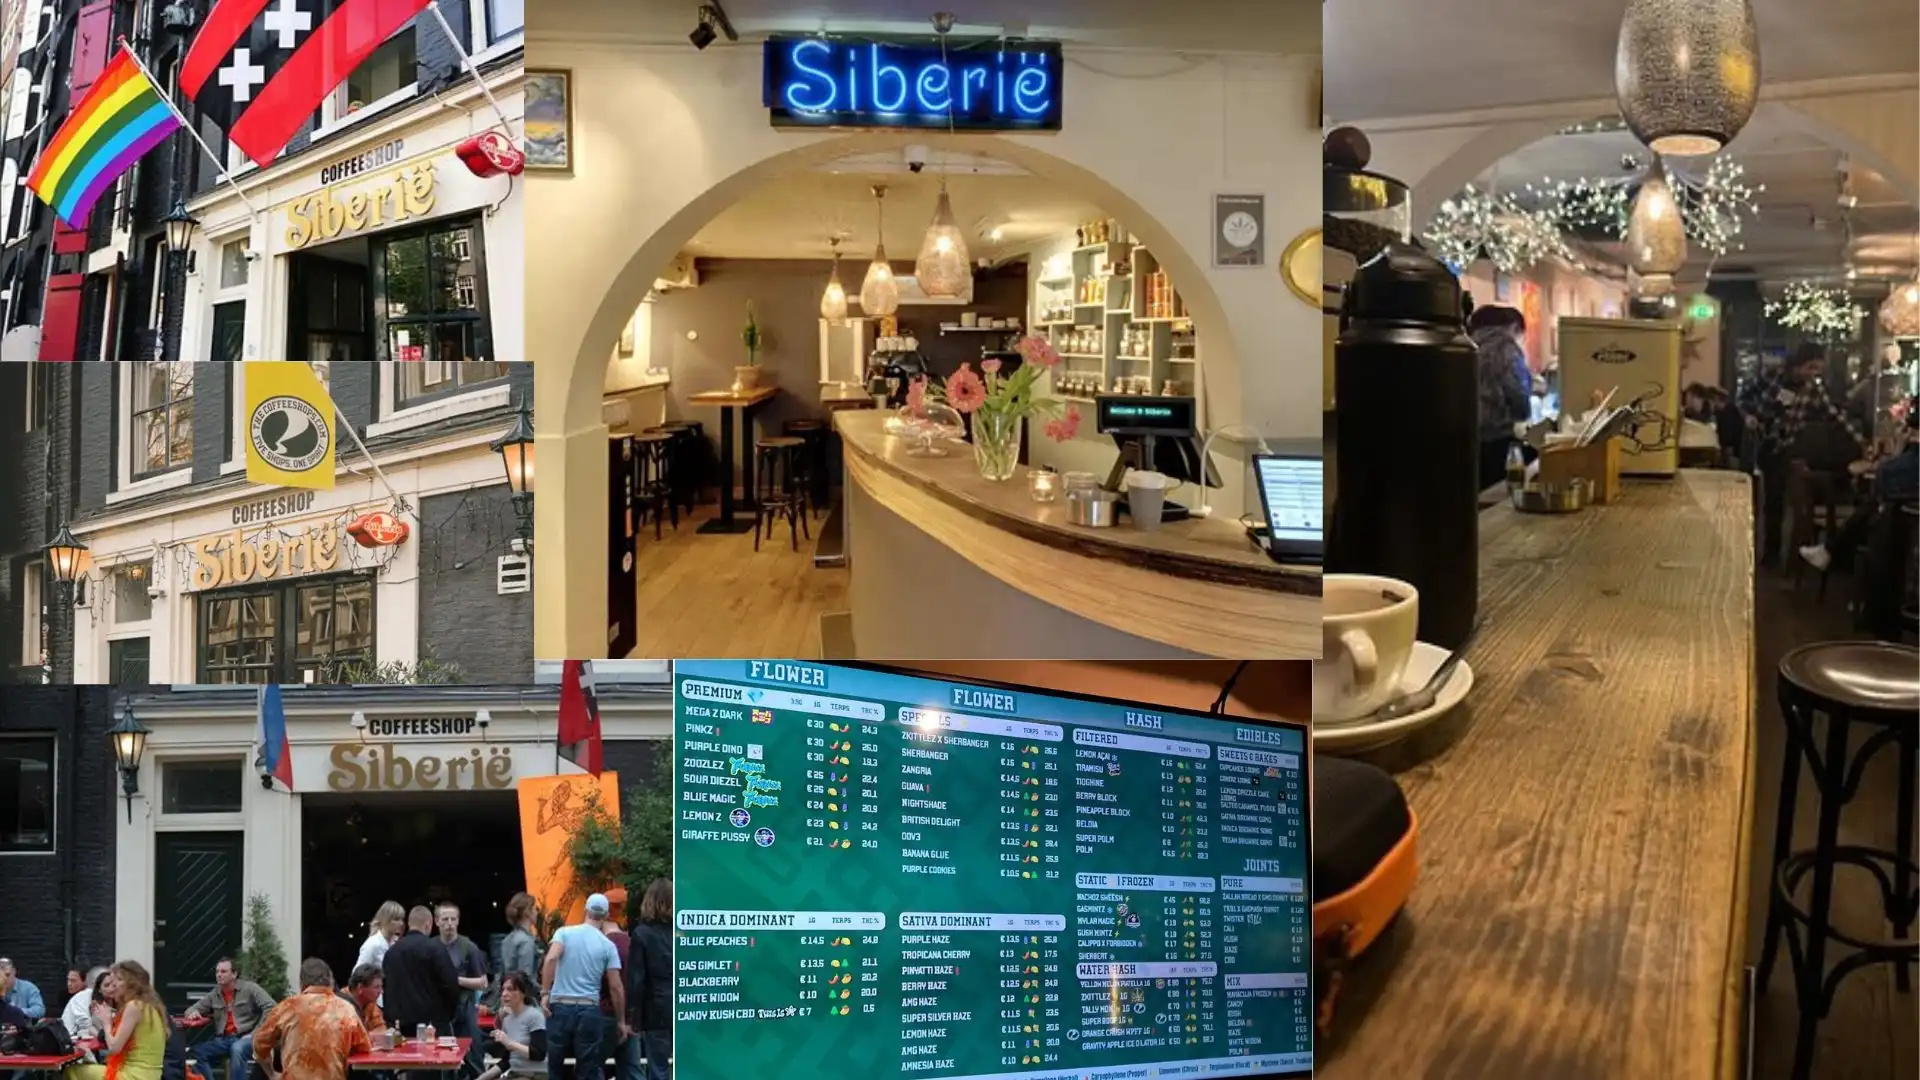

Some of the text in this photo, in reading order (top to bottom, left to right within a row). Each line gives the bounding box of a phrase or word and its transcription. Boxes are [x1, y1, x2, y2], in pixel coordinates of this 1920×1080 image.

[786, 40, 1051, 113] Siberië
[321, 139, 404, 185] COFFEESHOP
[285, 160, 437, 248] Siberië
[253, 410, 265, 430] THE
[254, 435, 268, 455] FIVE
[293, 460, 307, 469] ONE
[306, 444, 325, 465] SPIRIT
[232, 490, 315, 526] COFFEESHOP
[194, 519, 340, 590] Siberië
[750, 660, 825, 686] FLOWER
[685, 683, 743, 700] PREMIUM
[953, 688, 1014, 712] FLOWER
[685, 706, 711, 718] MEGA
[712, 708, 719, 718] Z
[720, 709, 743, 721] DARK
[901, 710, 951, 726] SPELS
[369, 717, 475, 736] COFFEESHOP
[1125, 711, 1162, 730] HASH
[685, 723, 713, 735] PINKZ
[1075, 731, 1118, 745] FILTERED
[1236, 727, 1281, 745] EDIBLES
[684, 740, 720, 753] PURPLE
[721, 744, 743, 755] DINO
[943, 736, 989, 749] SHERBANGER
[901, 748, 949, 761] SHERBANGER
[1075, 749, 1097, 759] LEMON
[1220, 749, 1249, 761] SWEETS
[1256, 752, 1278, 764] BAKES
[327, 743, 513, 792] Siberië
[901, 765, 932, 776] ZANGRIA
[1075, 763, 1104, 774] TIRAMISU
[683, 773, 709, 785] SOUR
[710, 775, 742, 787] DIEZEL
[901, 782, 924, 792] GUAVA
[683, 791, 708, 803] BLUE
[709, 793, 736, 804] MAGIC
[1075, 792, 1117, 802] BERRY BLOCK
[901, 798, 947, 810] NIGHTSHADE
[683, 810, 714, 821] LEMON
[715, 811, 722, 822] Z
[1076, 805, 1131, 817] PINEAPPLE BLOCK
[901, 815, 930, 825] BRITISH
[931, 817, 961, 827] DELIGHT
[682, 829, 720, 841] GIRAFFE
[721, 831, 750, 843] PUSSY
[1075, 833, 1115, 844] SUPER POLM
[902, 848, 930, 859] BANANA
[930, 850, 950, 860] GLUE
[1075, 846, 1093, 854] POLM
[902, 864, 928, 874] PURPLE
[929, 866, 956, 875] COOKIES
[1243, 859, 1280, 873] JOINTS
[1078, 875, 1154, 887] STATIC FROZEN
[1223, 878, 1244, 888] PURE
[681, 913, 726, 926] INDICA
[729, 914, 795, 926] DOMINANT
[902, 915, 992, 927] SATIVA DOMINANT
[679, 936, 705, 946] BLUE
[706, 936, 748, 946] PEACHES
[901, 935, 931, 944] PURPLE
[932, 935, 950, 944] HAZE
[901, 950, 942, 960] TROPICANA
[942, 950, 971, 959] CHERRY
[679, 961, 697, 971] GAS
[698, 960, 732, 970] GIMLET
[934, 966, 954, 975] HAZE
[1080, 965, 1110, 975] WATER
[678, 976, 740, 987] BLACKBERRY
[901, 982, 927, 991] BERRY
[928, 981, 947, 990] HAZE
[1226, 977, 1241, 986] MIX
[678, 993, 708, 1004] WHITE
[709, 992, 740, 1003] WIDOW
[901, 997, 918, 1007] AMG
[918, 997, 938, 1006] HAZE
[677, 1010, 708, 1021] CANDY
[709, 1009, 735, 1020] KUSH
[736, 1008, 755, 1018] CBD
[901, 1013, 927, 1023] SUPER
[927, 1012, 952, 1022] SILVER
[953, 1011, 972, 1021] HAZE
[901, 1029, 927, 1039] LEMON
[928, 1028, 947, 1038] HAZE
[901, 1045, 918, 1056] AMG
[918, 1044, 938, 1055] HAZE
[901, 1061, 935, 1072] AMNESIA
[935, 1059, 955, 1069] HAZE
